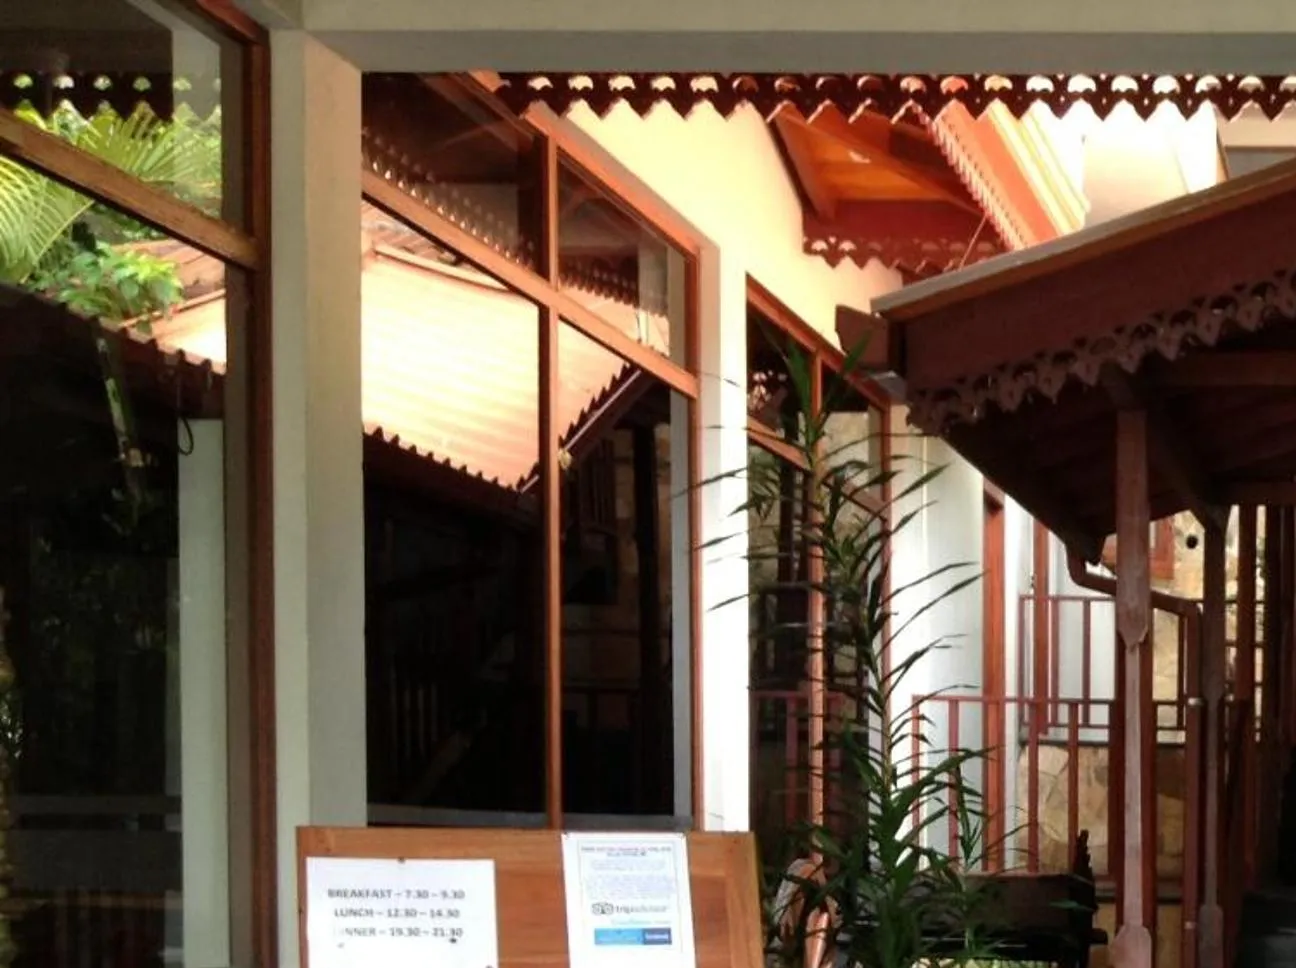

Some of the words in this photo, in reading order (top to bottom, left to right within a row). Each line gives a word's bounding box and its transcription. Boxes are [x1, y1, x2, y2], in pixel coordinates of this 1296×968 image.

[327, 888, 393, 899] BREAKFAST
[405, 889, 429, 899] 7.30
[334, 908, 374, 918] LUNCH
